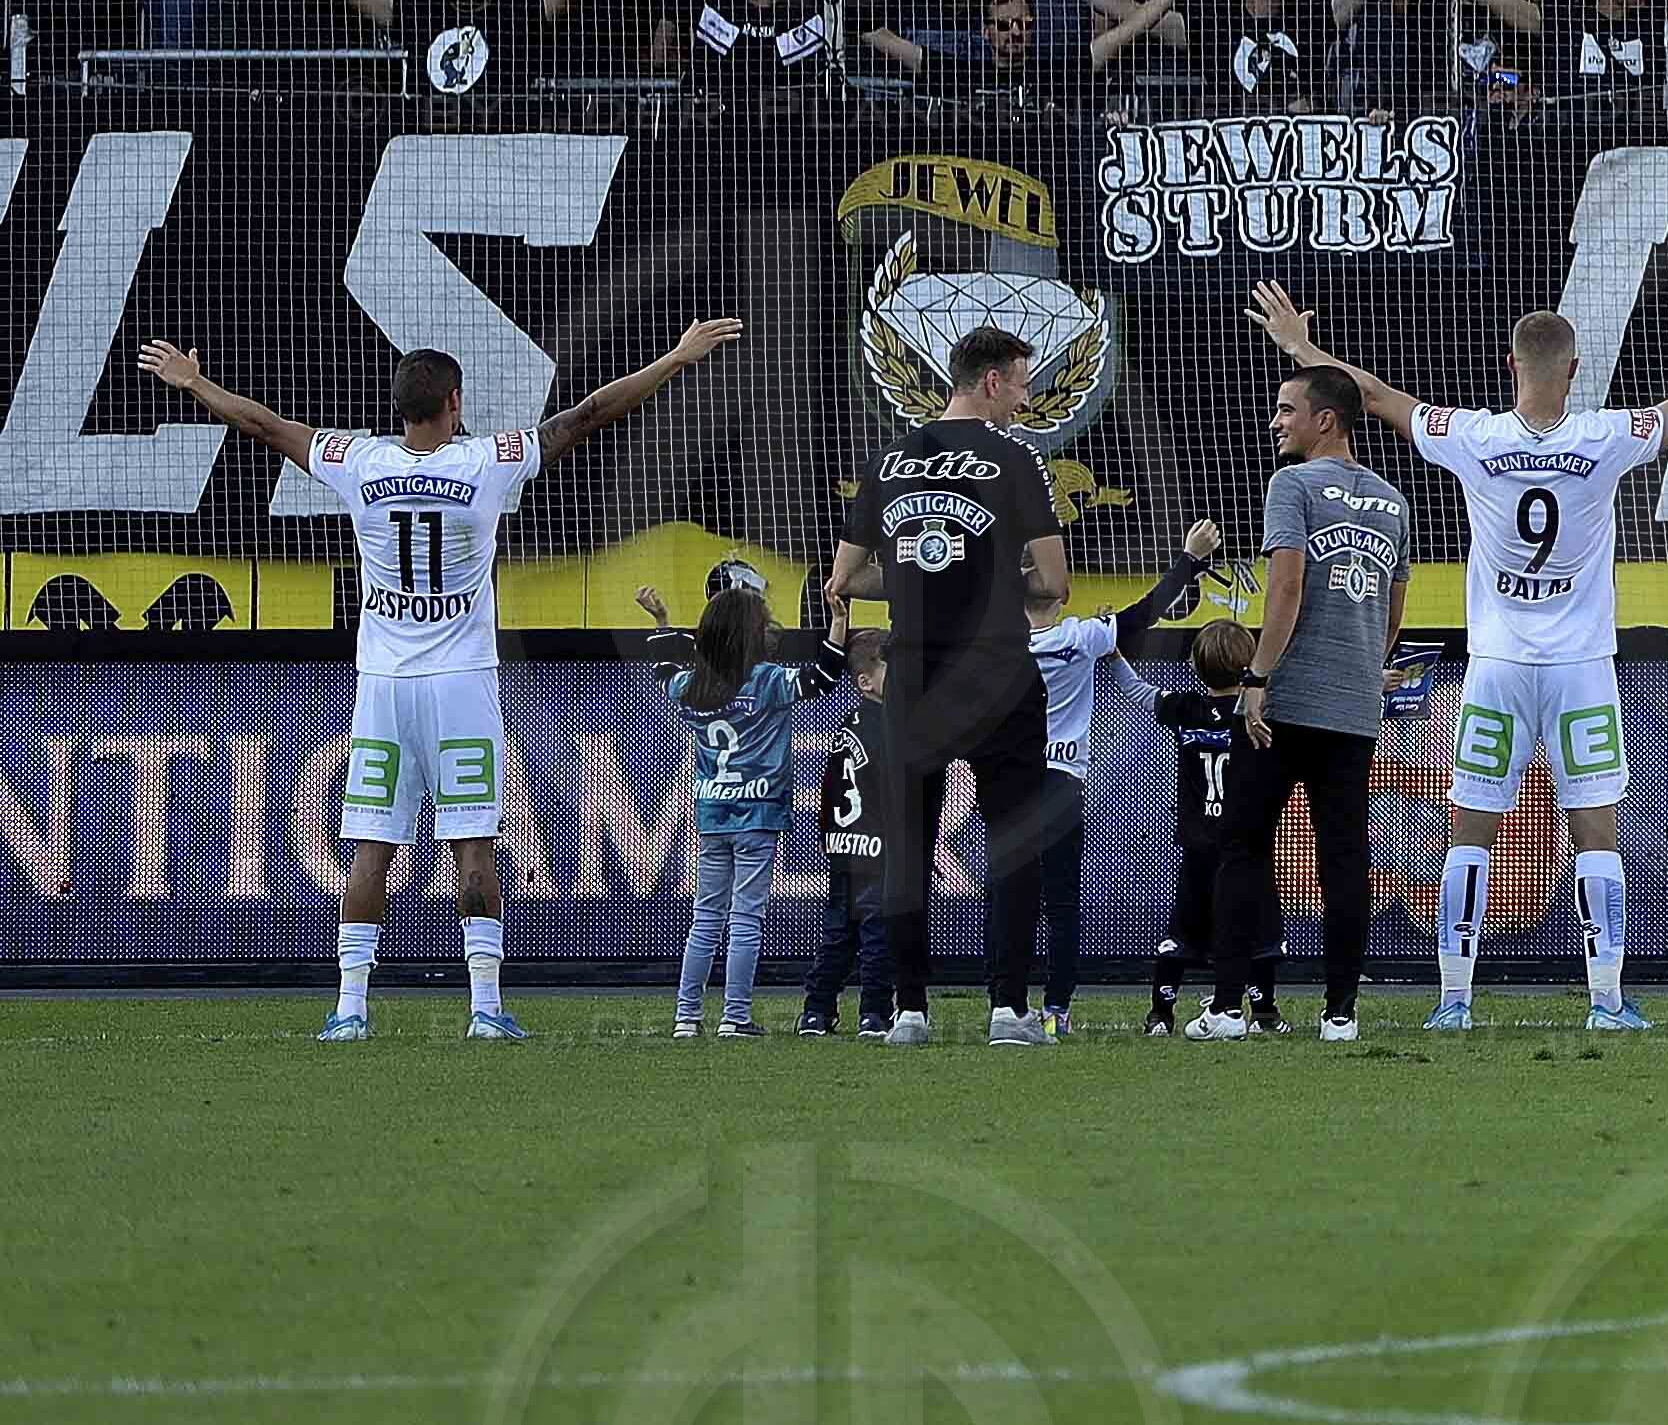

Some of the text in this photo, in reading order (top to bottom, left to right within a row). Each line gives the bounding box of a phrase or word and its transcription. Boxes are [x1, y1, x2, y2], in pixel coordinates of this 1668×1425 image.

[1099, 115, 1459, 189] JEWELS
[1100, 182, 1454, 262] STURM
[362, 476, 476, 505] PUNTIGAMER
[878, 450, 1002, 482] lotto
[1484, 453, 1596, 480] PUNTIGAMER
[883, 492, 995, 537] PUNTIGAMER
[1341, 488, 1402, 518] LOTTO
[389, 510, 443, 594] 11
[1515, 487, 1561, 574] 9
[364, 589, 477, 623] DESPODOV
[707, 719, 743, 783] 2
[833, 757, 863, 828] 3
